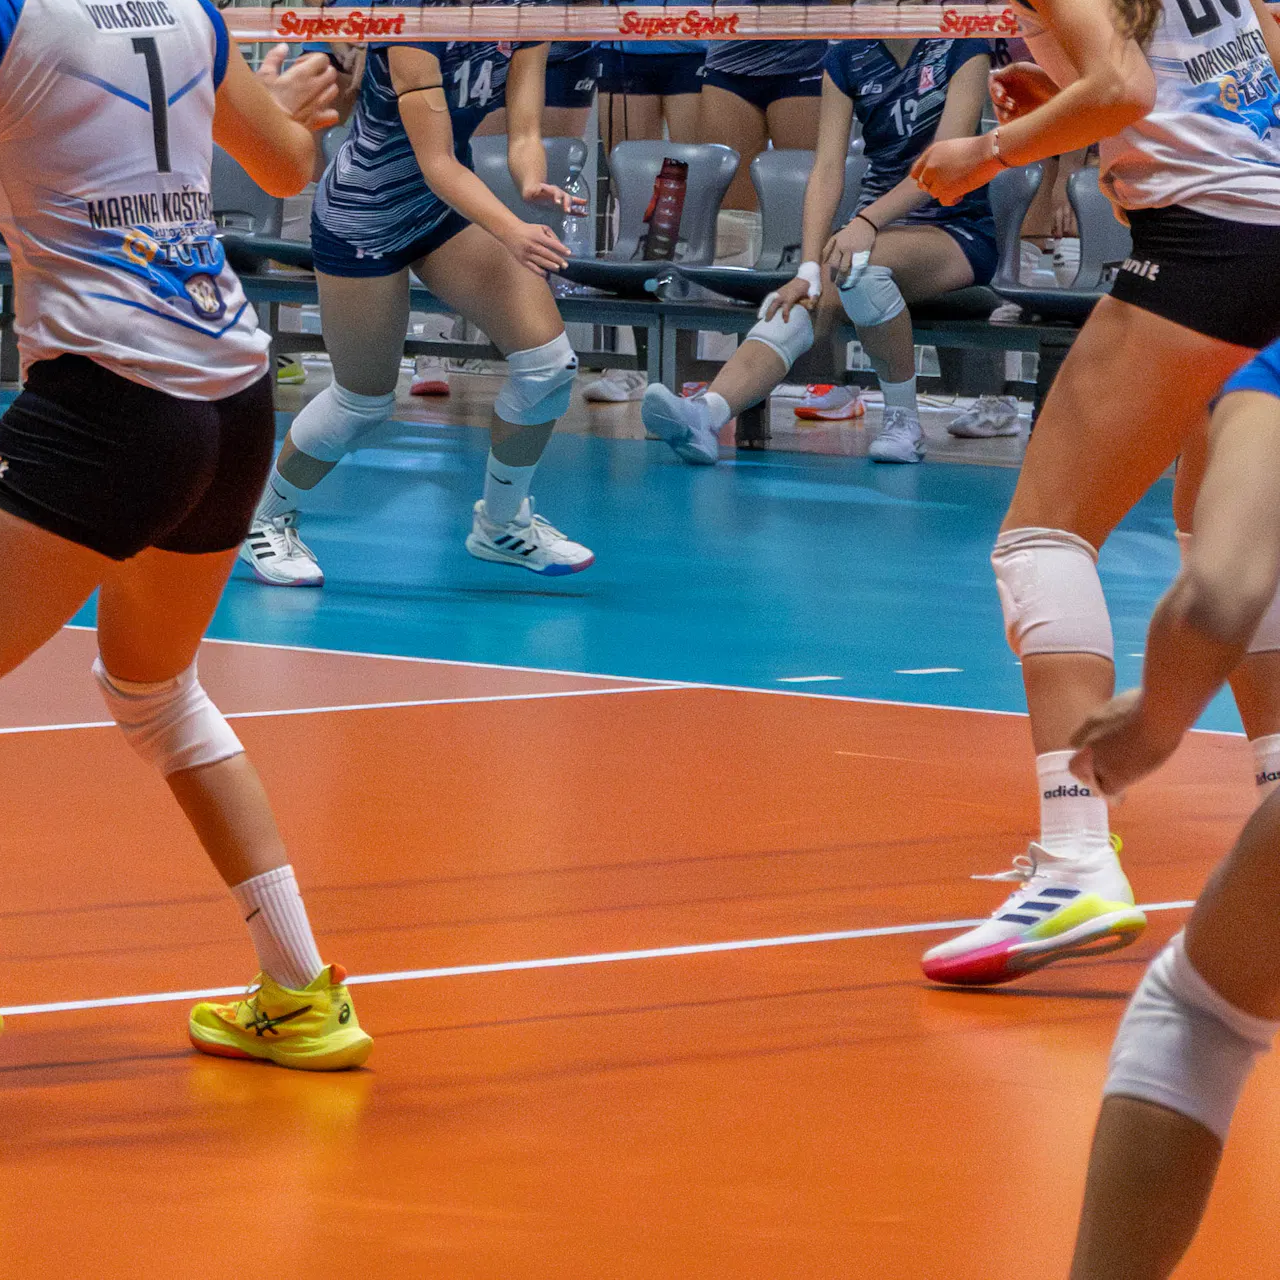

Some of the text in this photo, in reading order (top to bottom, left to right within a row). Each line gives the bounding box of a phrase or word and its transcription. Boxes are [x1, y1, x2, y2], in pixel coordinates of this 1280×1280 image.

[276, 10, 406, 39] SuperSport
[617, 9, 740, 37] SuperSport
[453, 60, 494, 109] 14
[130, 37, 172, 173] 1
[88, 192, 160, 229] MARINA
[1043, 784, 1091, 799] adida
